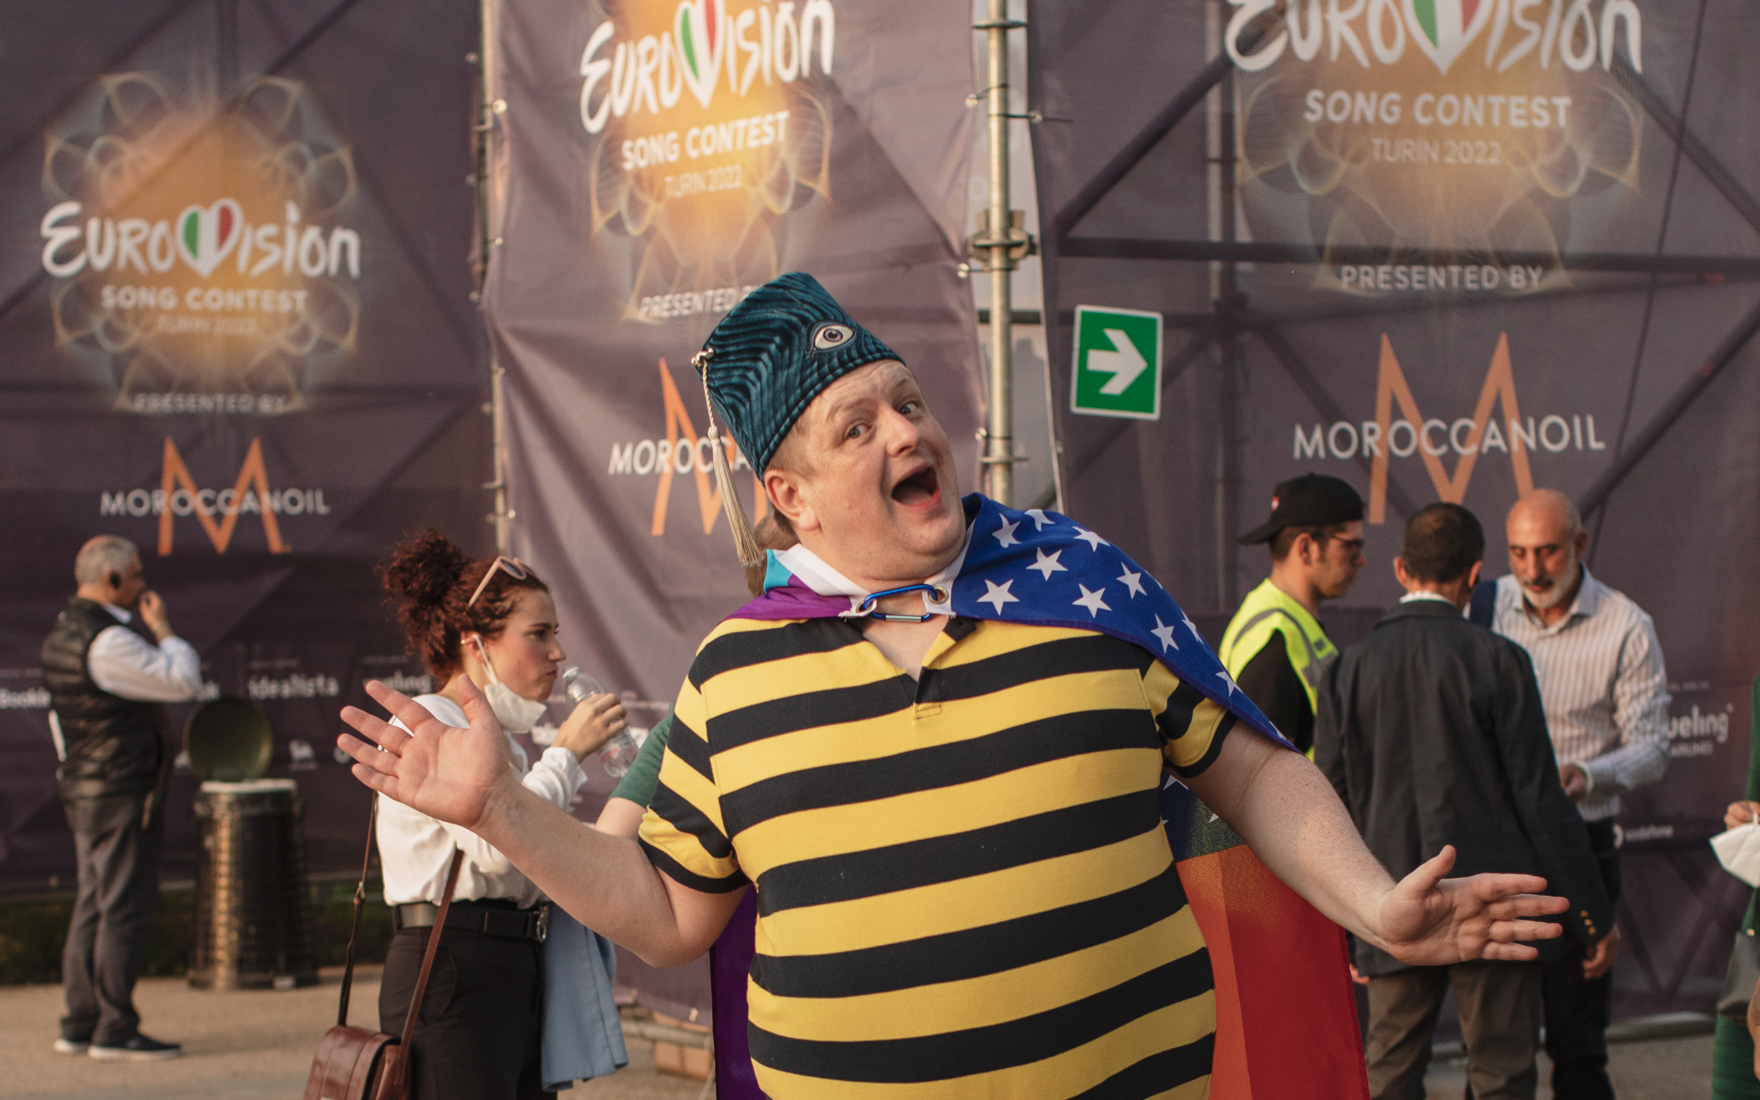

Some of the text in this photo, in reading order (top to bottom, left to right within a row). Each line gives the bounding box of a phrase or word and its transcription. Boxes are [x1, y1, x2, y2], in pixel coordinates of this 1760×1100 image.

[1304, 89, 1572, 128] SONG CONTEST
[621, 110, 790, 171] SONG CONTEST
[1371, 138, 1502, 165] TURIN 2022
[708, 164, 743, 192] 2022
[1341, 265, 1543, 290] PRESENTED BY
[101, 285, 309, 314] SONG CONTEST
[639, 287, 738, 319] PRESENTED
[134, 392, 255, 414] PRESENTED
[1293, 414, 1605, 460] MOROCCANOIL
[101, 488, 330, 517] MOROCCANOIL
[248, 672, 340, 700] idealista
[1666, 704, 1730, 744] ueling
